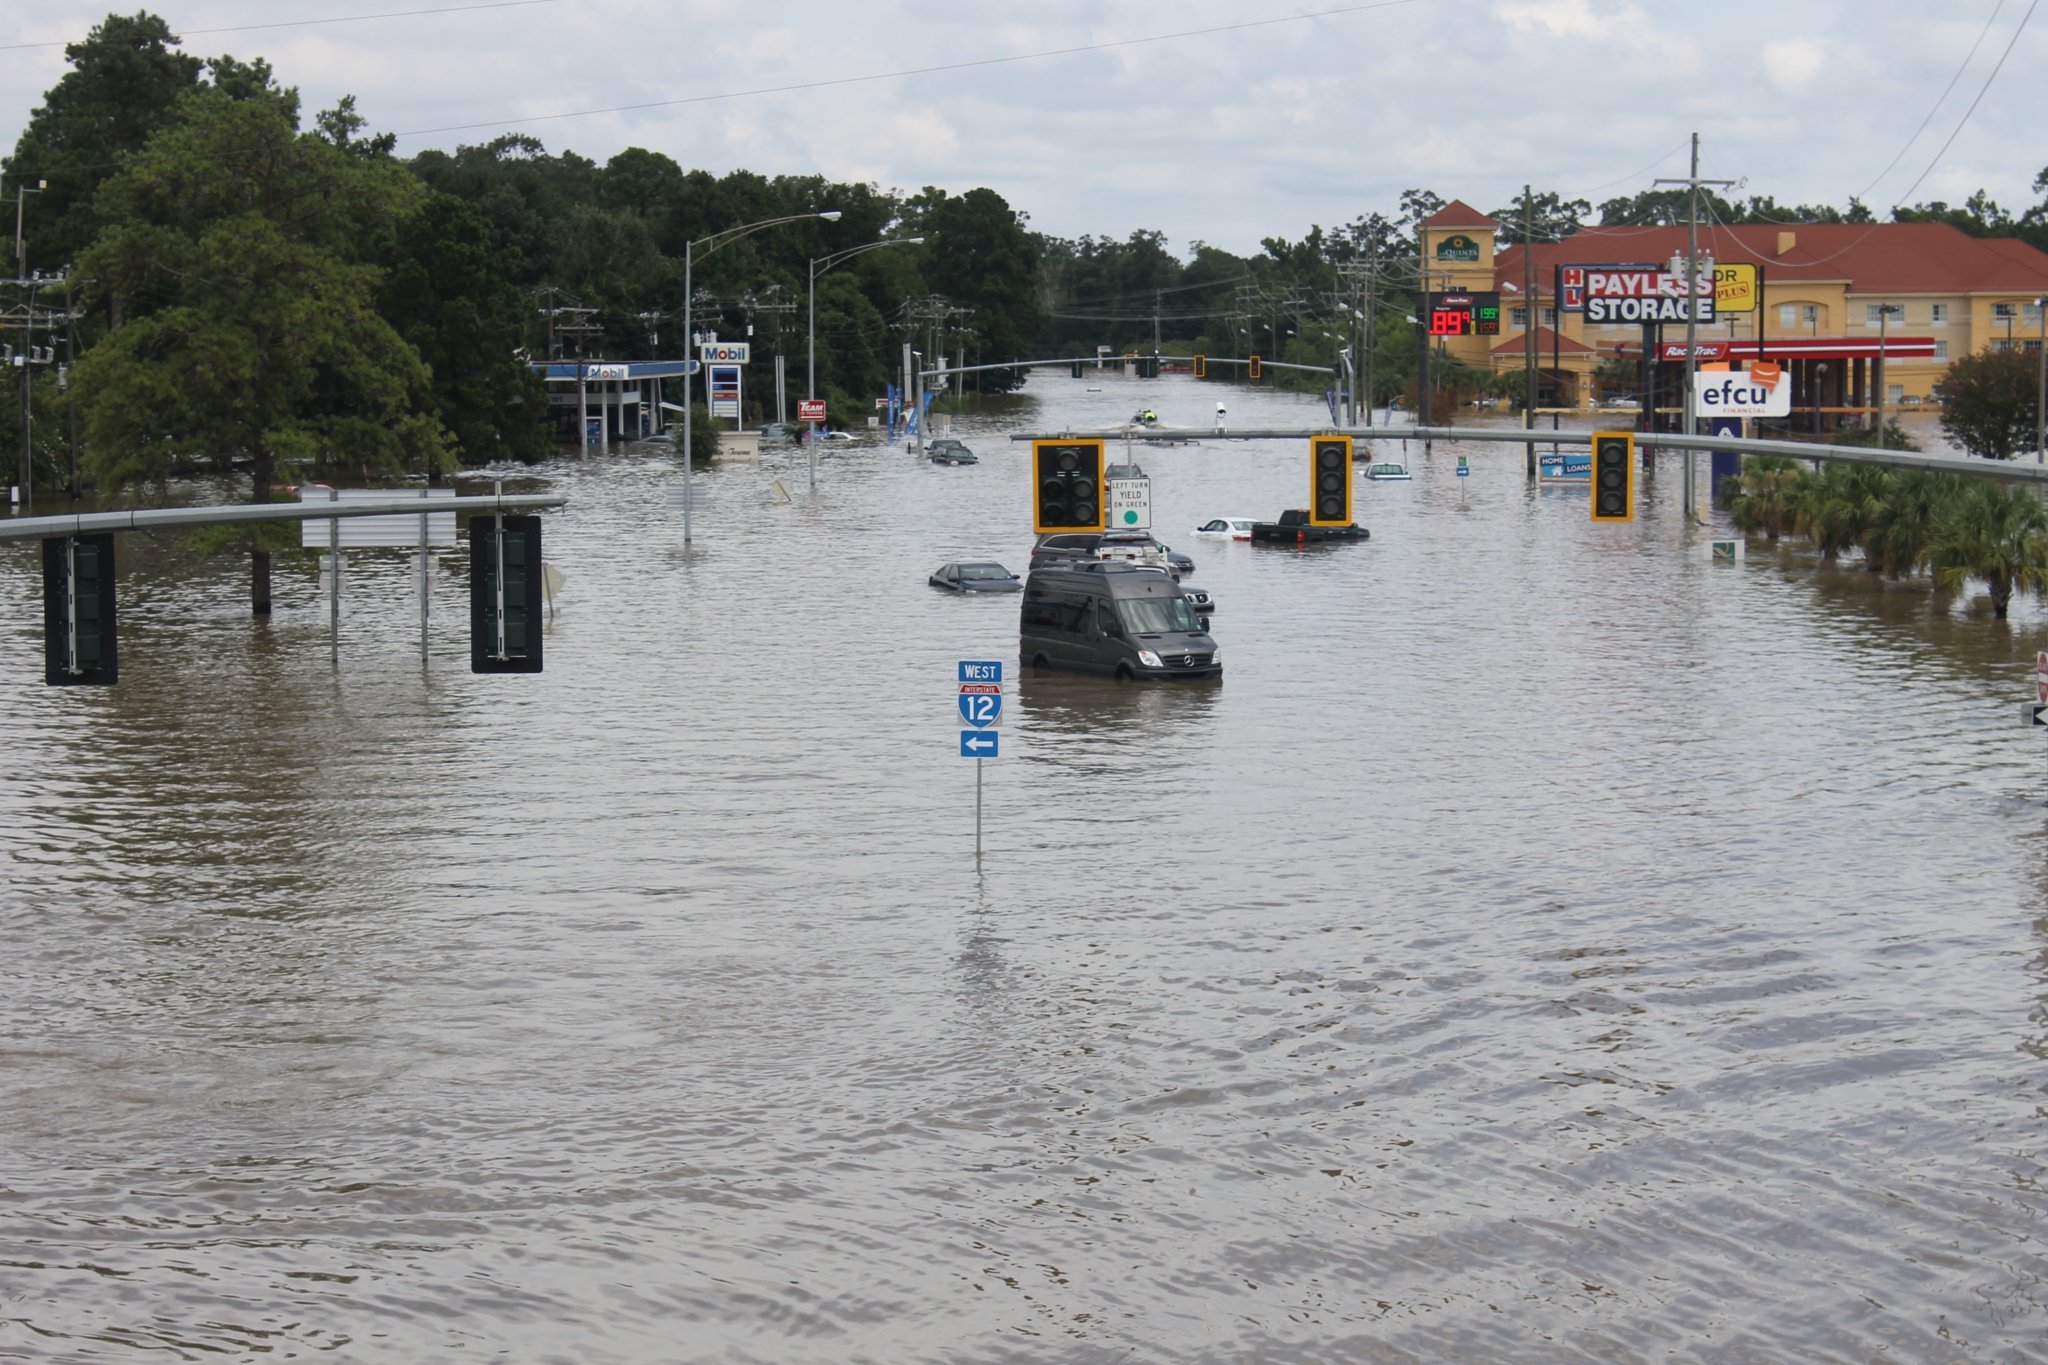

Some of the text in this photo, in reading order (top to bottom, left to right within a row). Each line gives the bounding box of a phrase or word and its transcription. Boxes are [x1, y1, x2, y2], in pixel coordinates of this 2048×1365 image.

[1445, 248, 1478, 256] QUINTA
[1588, 273, 1713, 295] PAYLESS
[1588, 297, 1713, 320] STORAGE
[705, 347, 745, 360] Mobil
[591, 368, 624, 378] Mobil
[1703, 380, 1767, 405] efcu
[1567, 464, 1591, 472] LOANS
[1120, 491, 1142, 499] YIELD
[964, 664, 996, 679] WEST
[967, 695, 994, 720] 12
